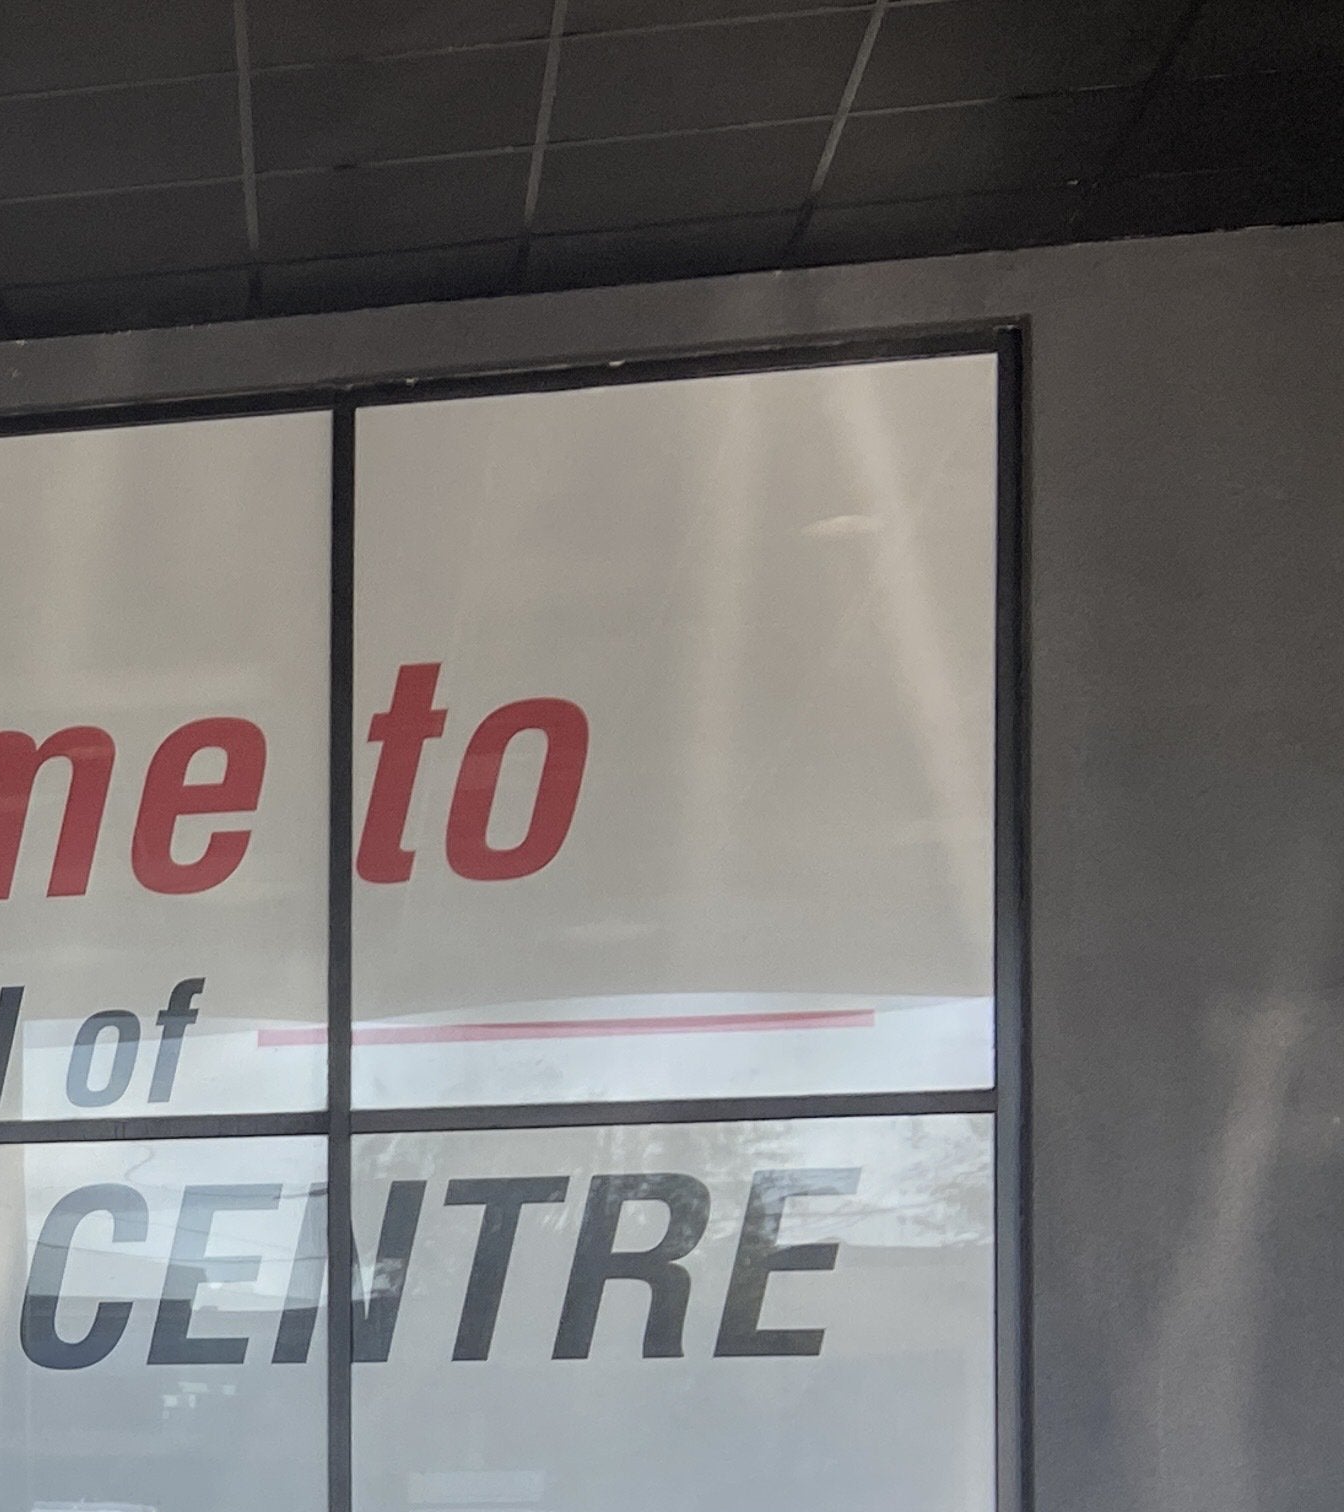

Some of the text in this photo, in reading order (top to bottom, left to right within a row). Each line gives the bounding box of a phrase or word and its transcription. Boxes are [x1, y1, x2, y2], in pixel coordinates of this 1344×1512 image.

[354, 661, 590, 883] to
[64, 977, 206, 1109] of
[20, 1167, 860, 1370] CENTRE
